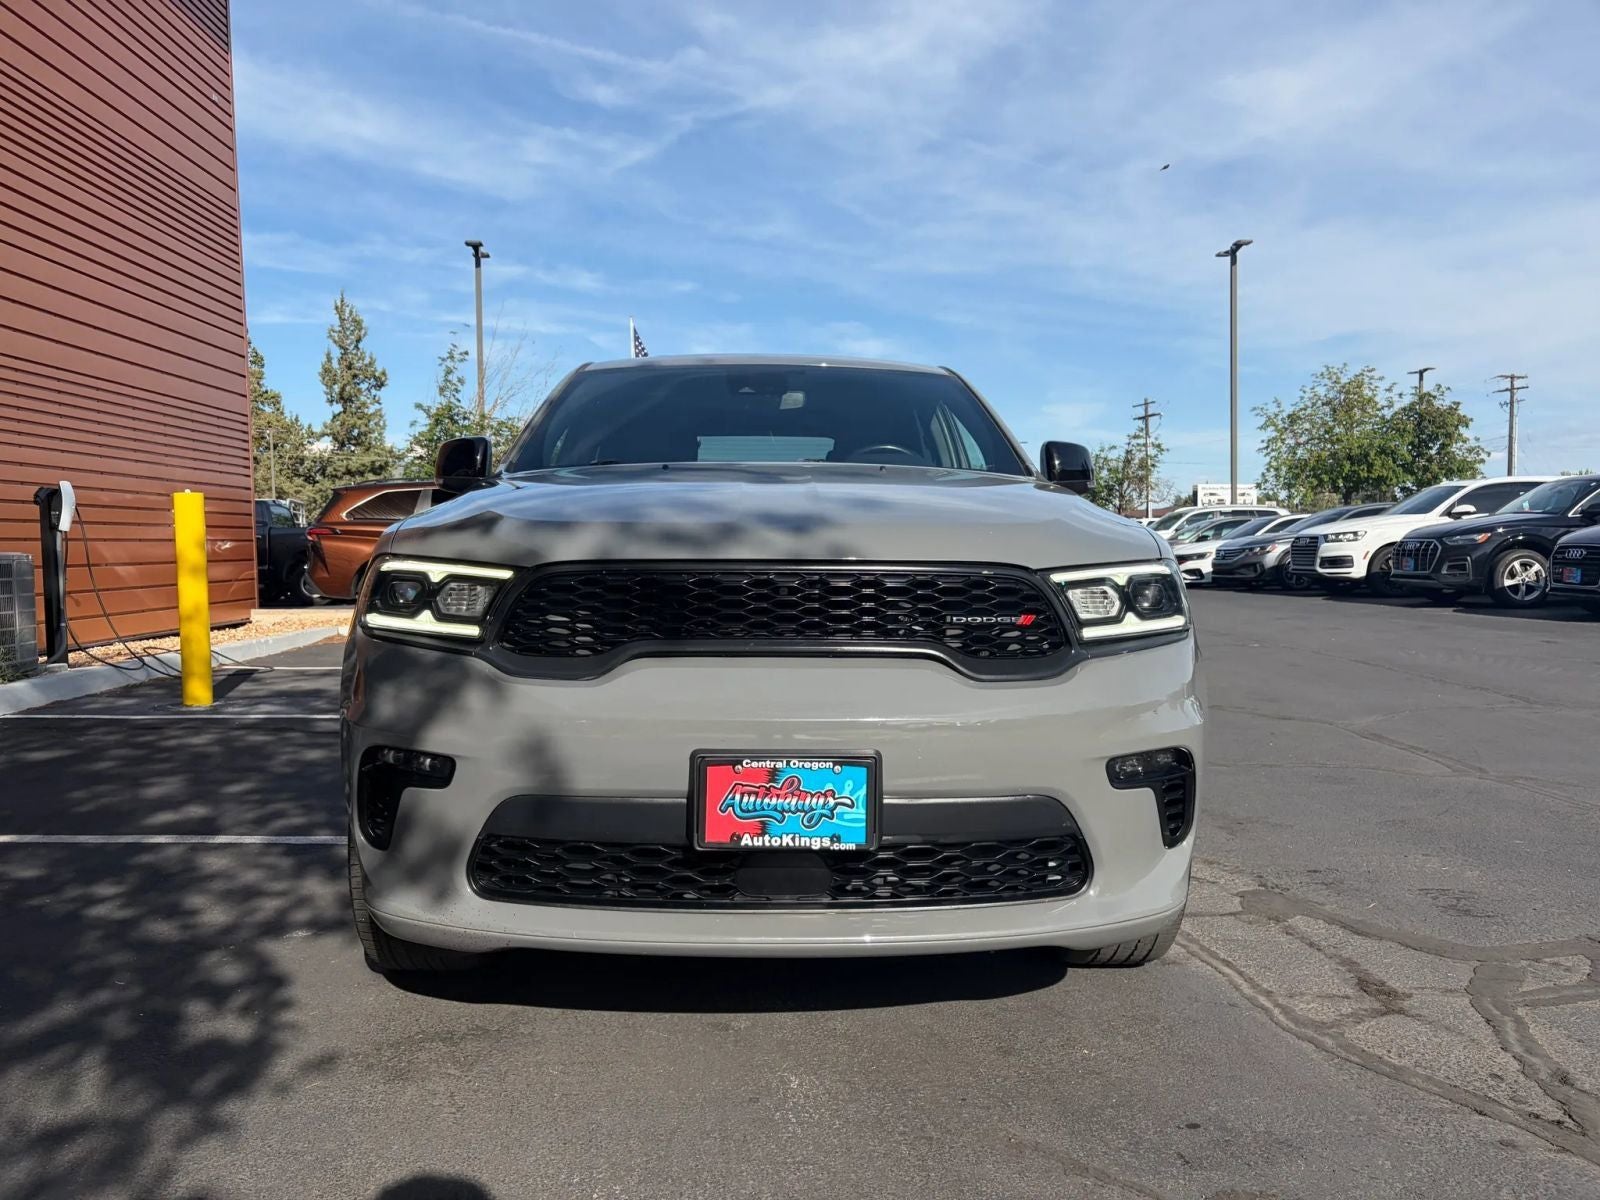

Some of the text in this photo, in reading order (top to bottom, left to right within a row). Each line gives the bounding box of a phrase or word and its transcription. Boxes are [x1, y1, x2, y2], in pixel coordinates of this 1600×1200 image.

[742, 759, 833, 771] Central Oregon
[740, 833, 856, 851] AutoKings.com
